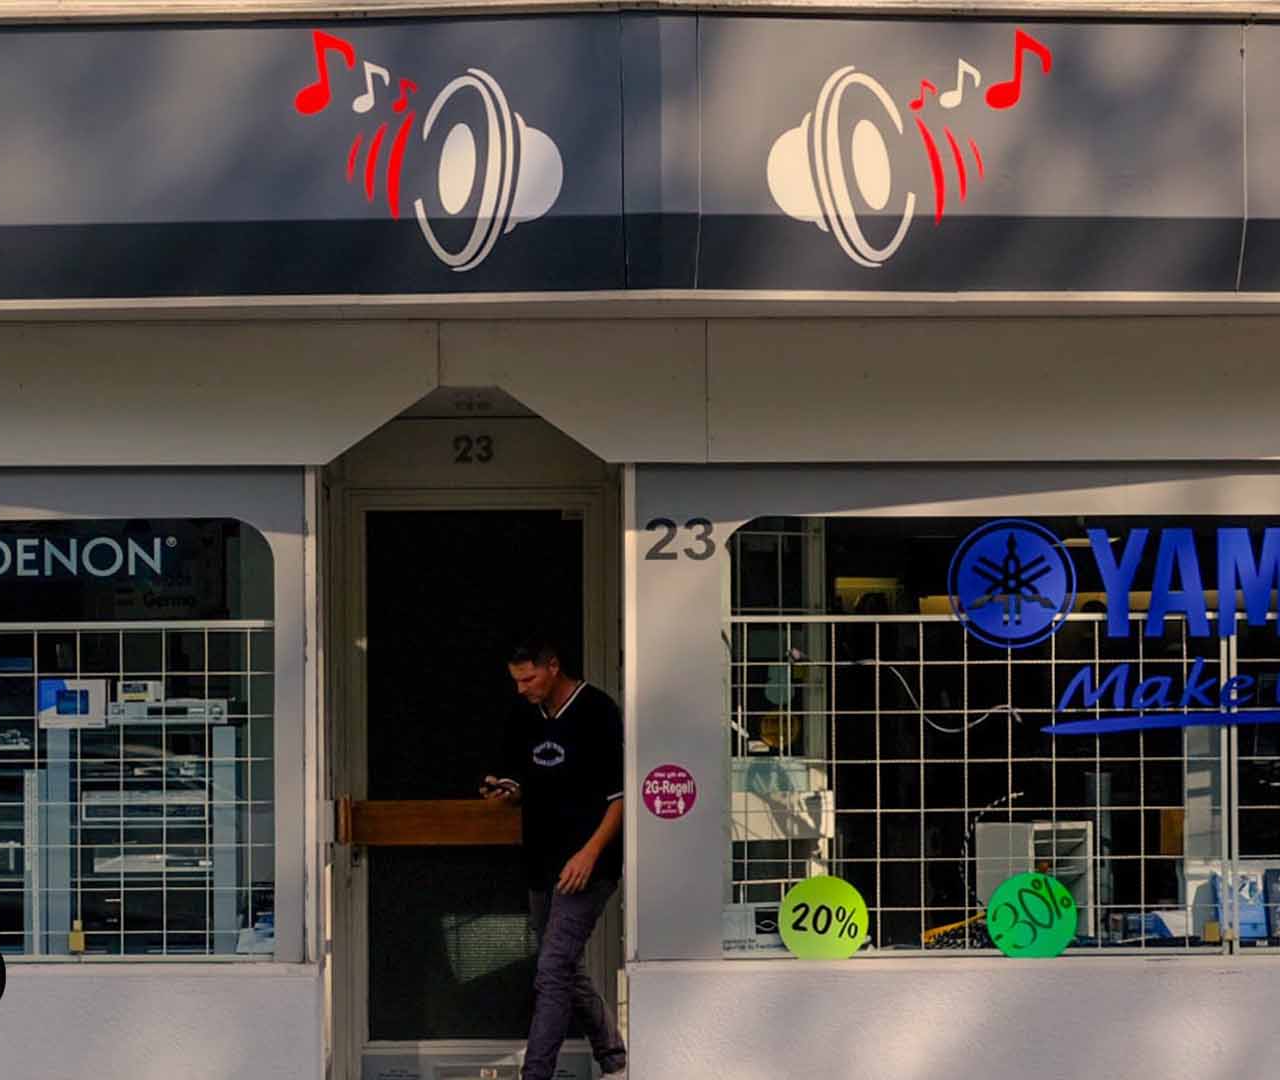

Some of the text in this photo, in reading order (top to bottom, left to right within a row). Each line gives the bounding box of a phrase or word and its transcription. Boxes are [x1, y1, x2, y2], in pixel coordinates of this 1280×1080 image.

[452, 434, 495, 464] 23
[644, 517, 716, 561] 23
[1057, 656, 1255, 712] Make
[790, 902, 859, 940] 20%
